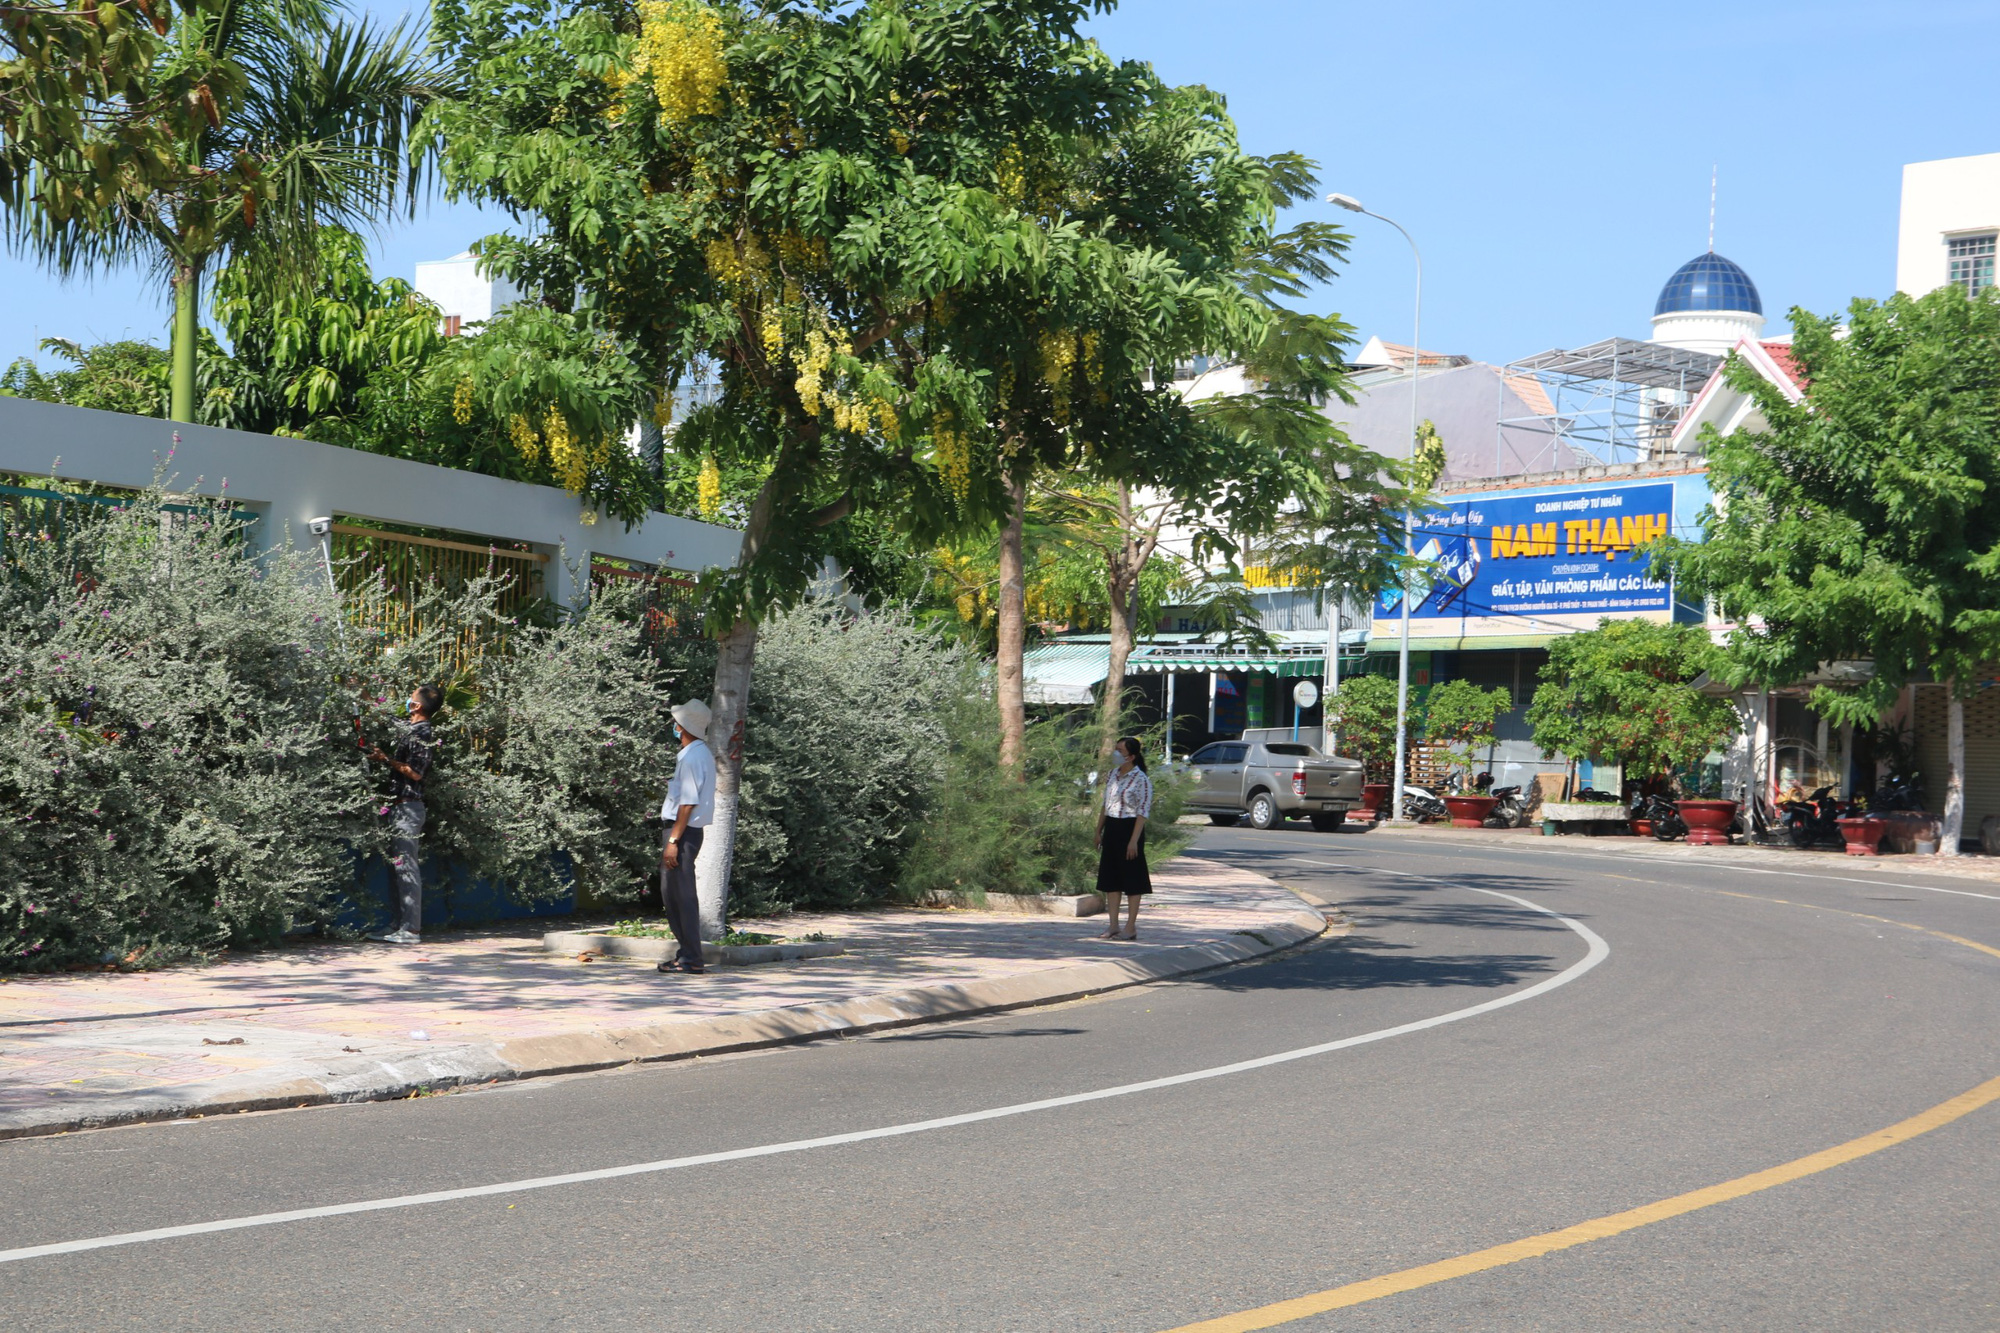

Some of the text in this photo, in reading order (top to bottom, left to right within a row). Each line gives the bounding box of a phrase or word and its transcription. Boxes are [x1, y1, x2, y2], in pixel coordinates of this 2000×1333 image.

[1535, 495, 1623, 513] DOANH NGHIỆP TƯ NHÂN
[1451, 511, 1467, 524] Cao
[1467, 510, 1484, 526] Cấp
[1491, 521, 1558, 559] NAM
[1563, 513, 1668, 561] THẠNH
[1491, 578, 1515, 598] GIẤY,
[1515, 579, 1533, 599] TẬP,
[1534, 579, 1553, 595] VĂN
[1554, 577, 1589, 594] PHÒNG
[1589, 572, 1617, 593] PHẨM
[1618, 574, 1641, 591] CÁC
